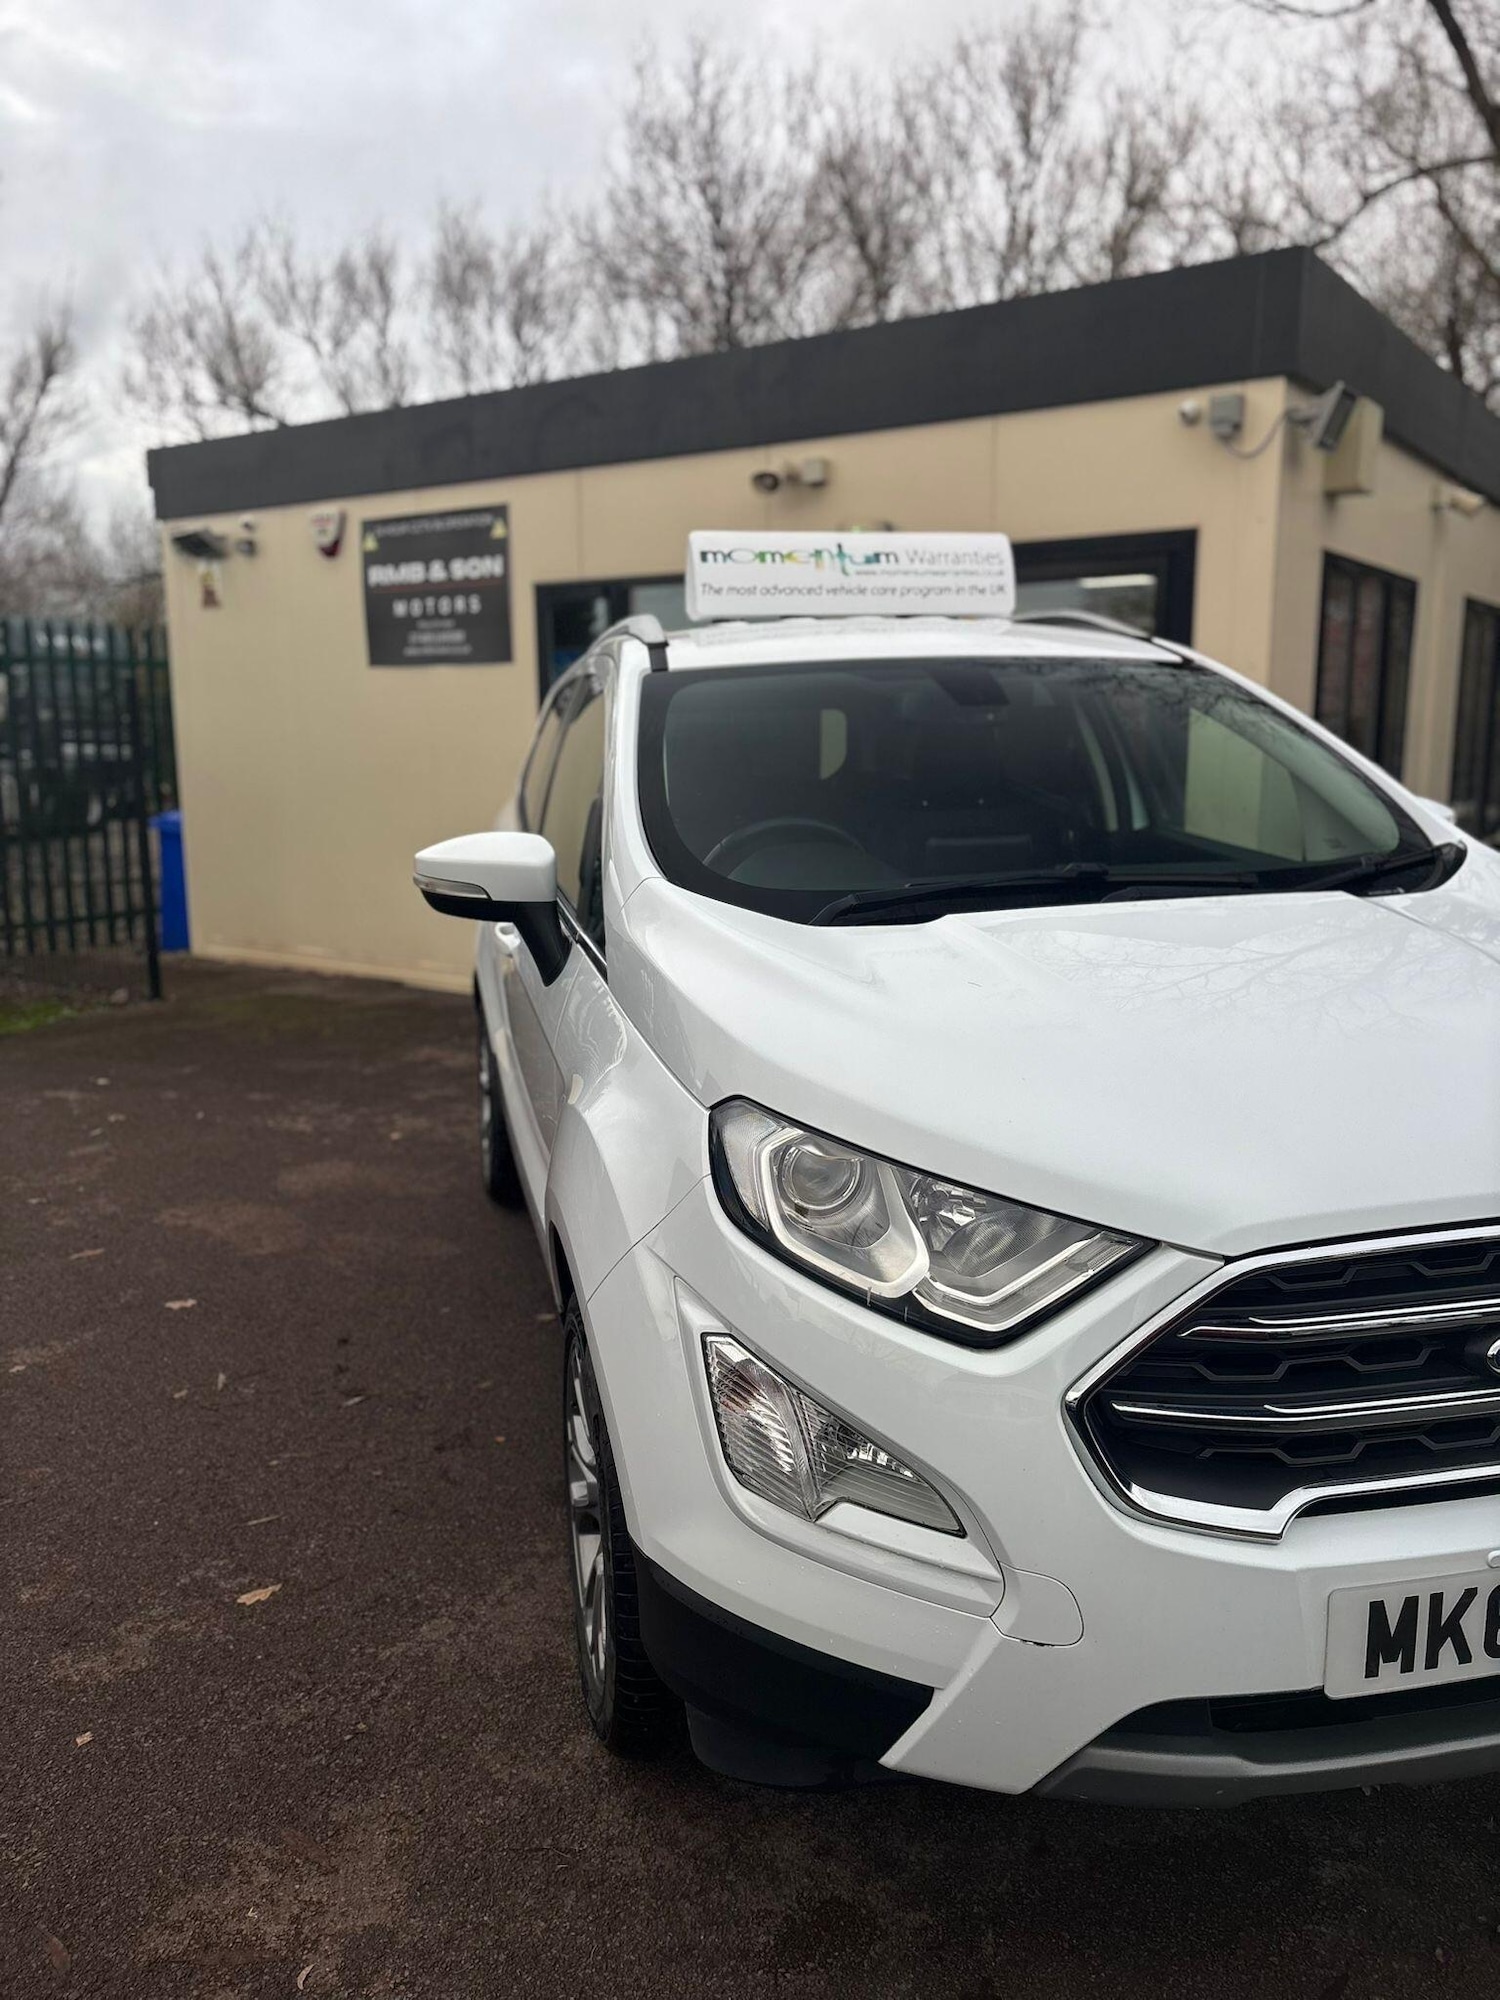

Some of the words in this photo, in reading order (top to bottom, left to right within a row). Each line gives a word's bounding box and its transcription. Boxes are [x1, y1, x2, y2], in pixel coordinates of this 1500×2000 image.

[428, 558, 448, 583] &
[449, 553, 504, 581] SON
[700, 543, 899, 576] momentum
[905, 549, 1005, 566] Warranties
[701, 583, 723, 596] The
[726, 584, 757, 596] most
[760, 582, 823, 597] advanced
[826, 583, 867, 597] vehicle
[870, 585, 897, 597] care
[900, 585, 952, 599] program
[955, 584, 967, 596] in
[968, 583, 987, 596] the
[392, 594, 482, 618] MOTORS
